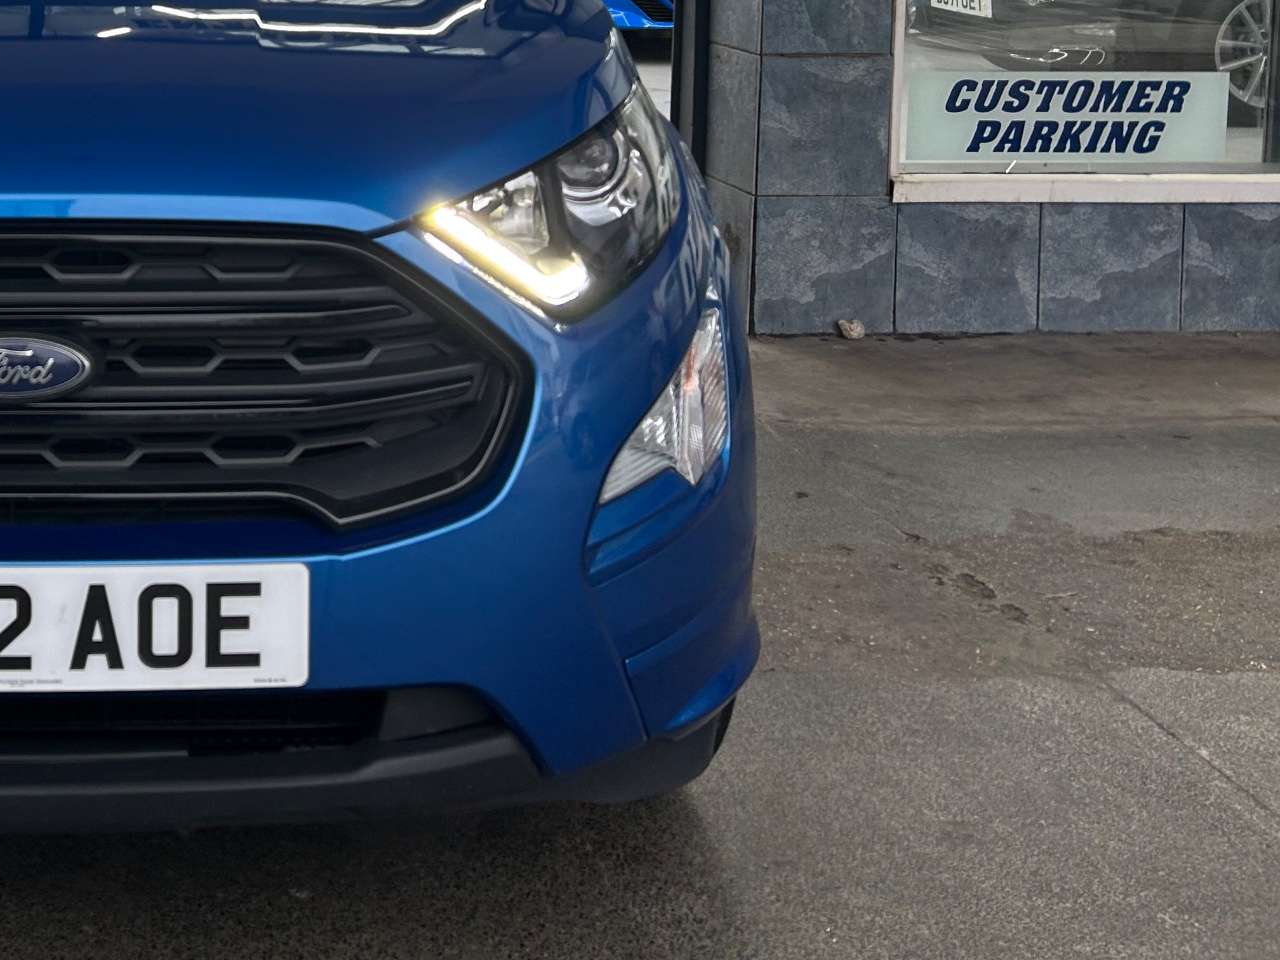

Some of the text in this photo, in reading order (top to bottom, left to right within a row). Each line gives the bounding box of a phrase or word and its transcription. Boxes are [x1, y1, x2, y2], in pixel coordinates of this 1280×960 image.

[945, 79, 1191, 113] CUSTOMER
[966, 120, 1166, 154] PARKING
[70, 582, 262, 670] AOE
